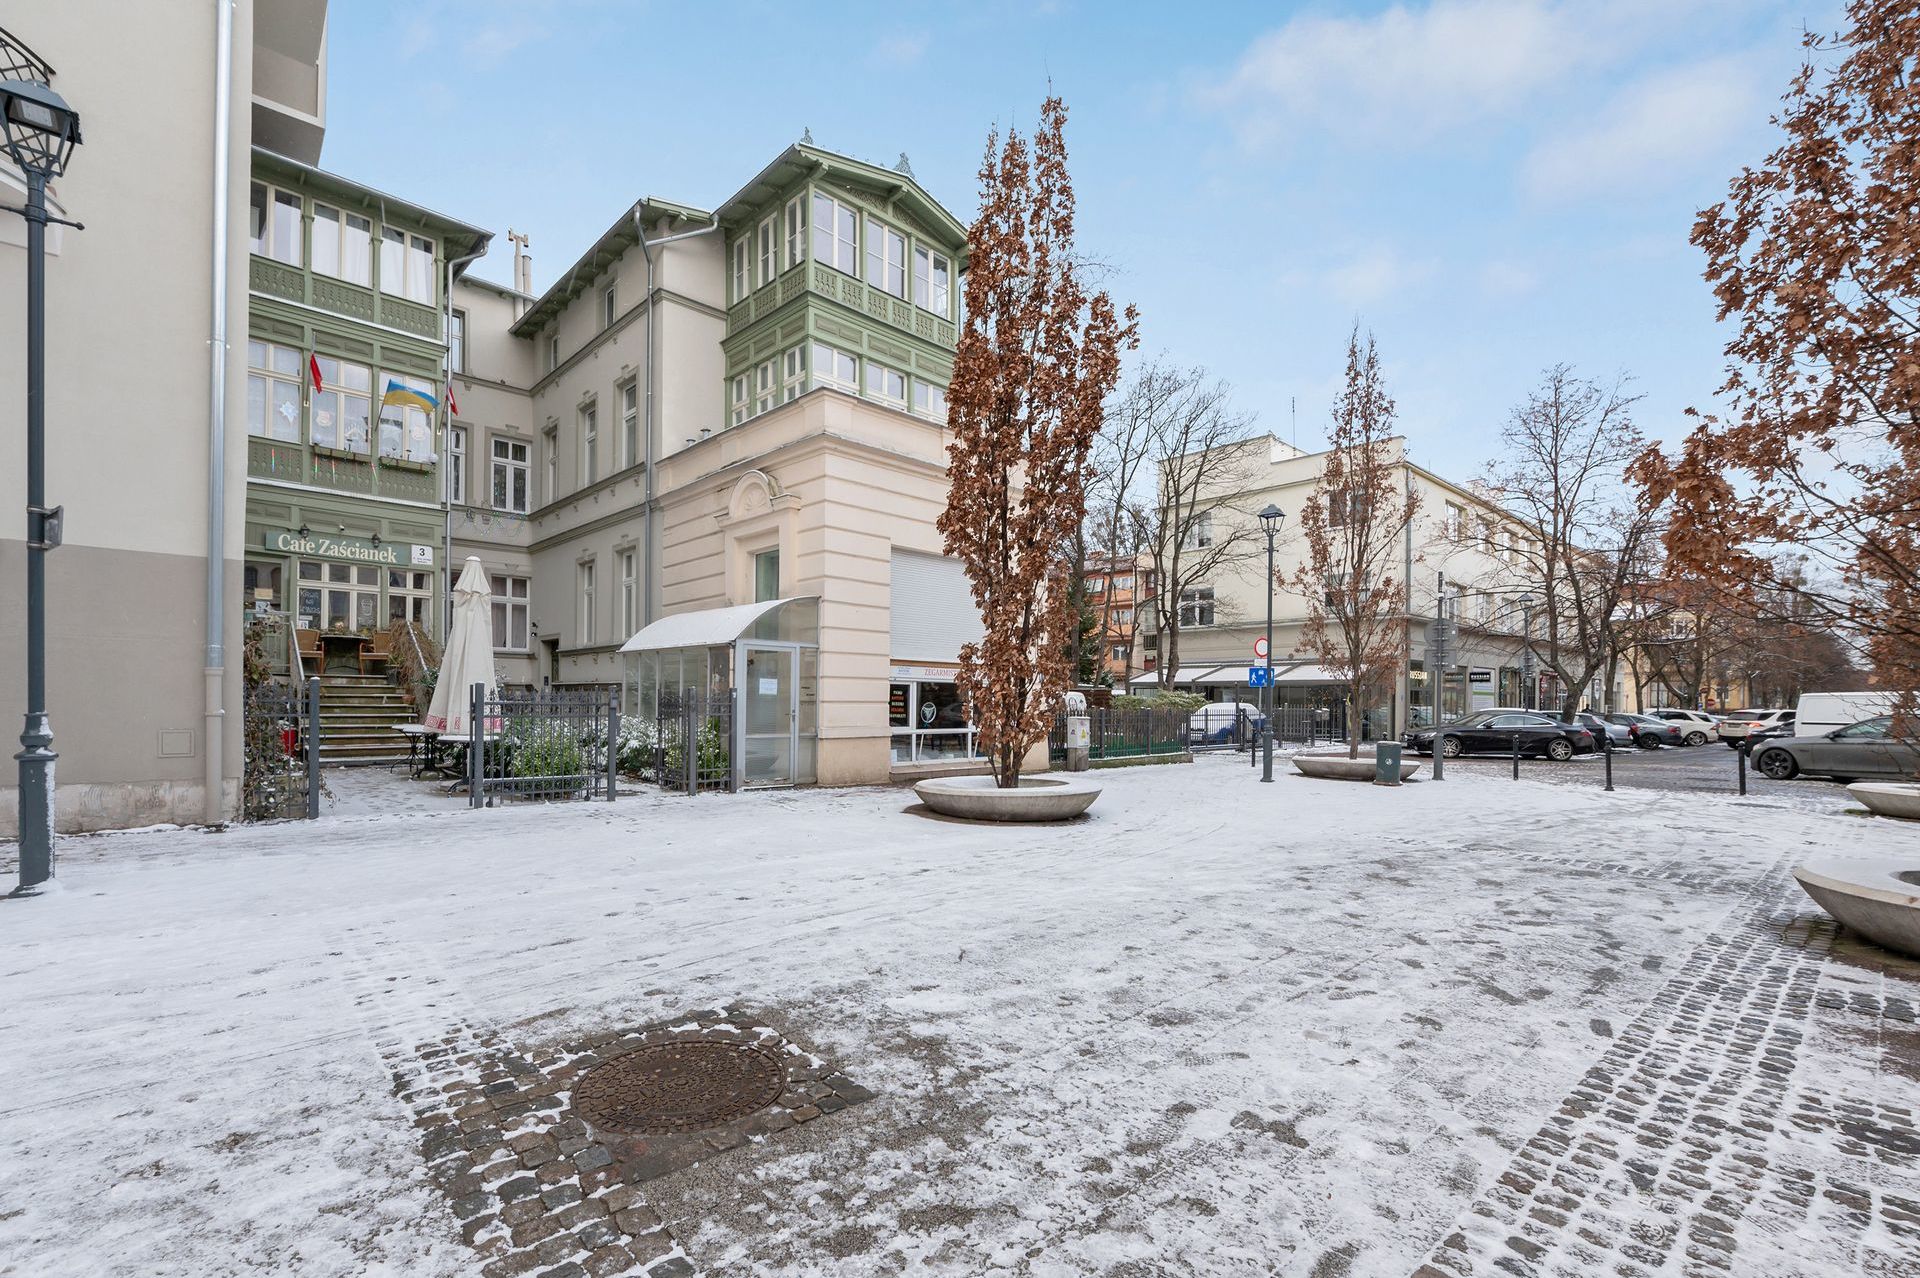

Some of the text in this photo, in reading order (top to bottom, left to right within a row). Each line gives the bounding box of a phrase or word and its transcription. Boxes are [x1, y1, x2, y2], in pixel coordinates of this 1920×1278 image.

[319, 539, 397, 563] Zaścianek
[419, 547, 426, 557] 3
[924, 668, 955, 676] ZEGARMIS
